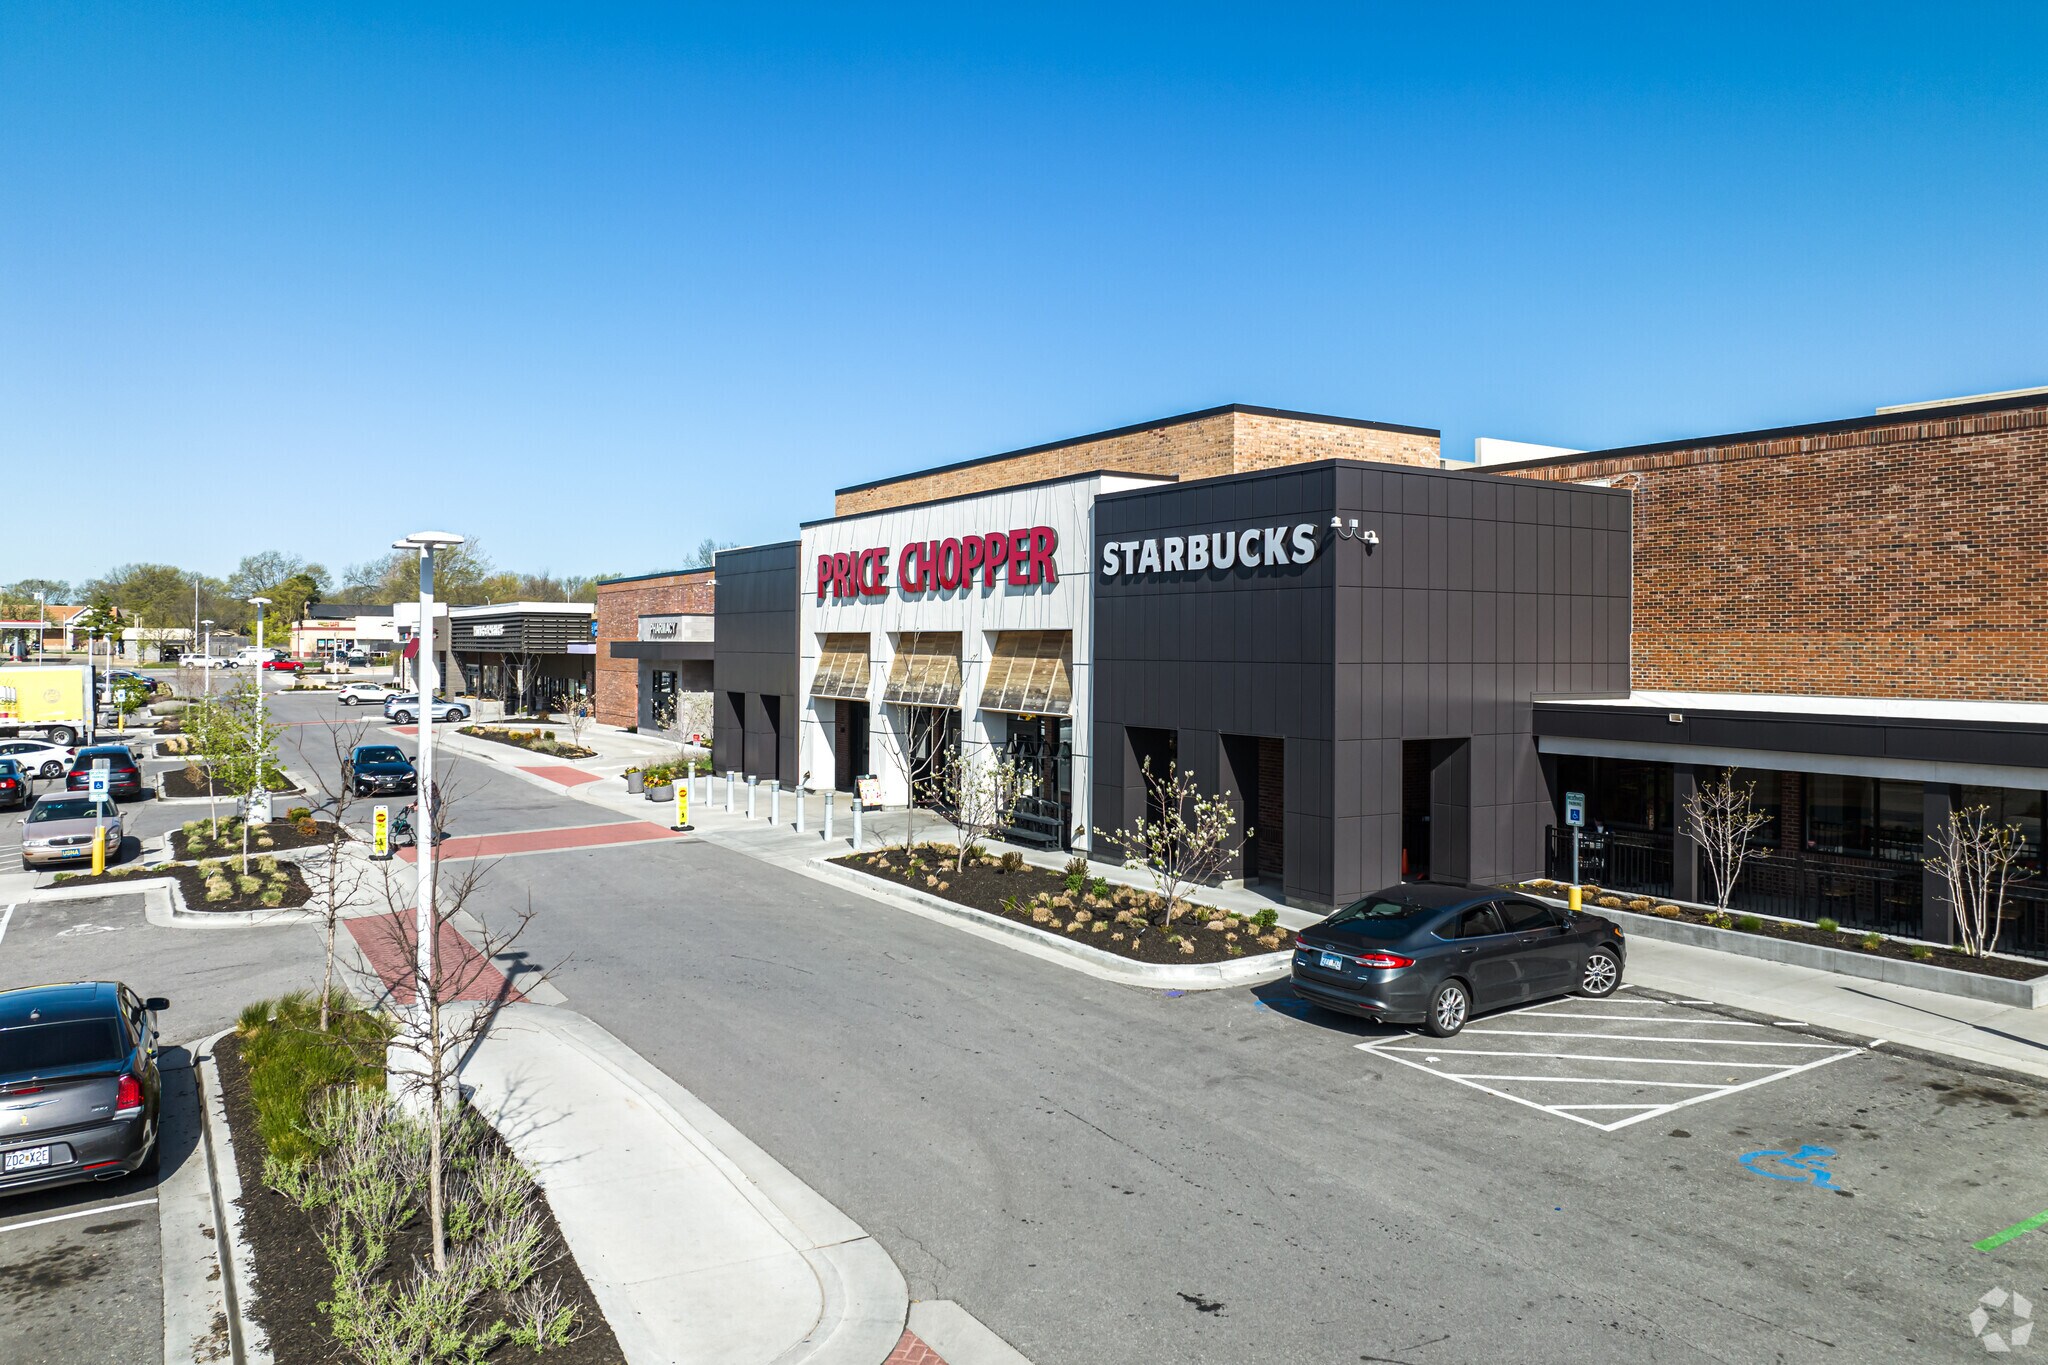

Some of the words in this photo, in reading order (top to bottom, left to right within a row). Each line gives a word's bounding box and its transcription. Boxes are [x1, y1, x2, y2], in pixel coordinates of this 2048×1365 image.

[817, 546, 889, 599] PRICE
[898, 525, 1059, 594] CHOPPER
[1102, 523, 1318, 577] STARBUCKS
[649, 622, 678, 635] PHARMACY
